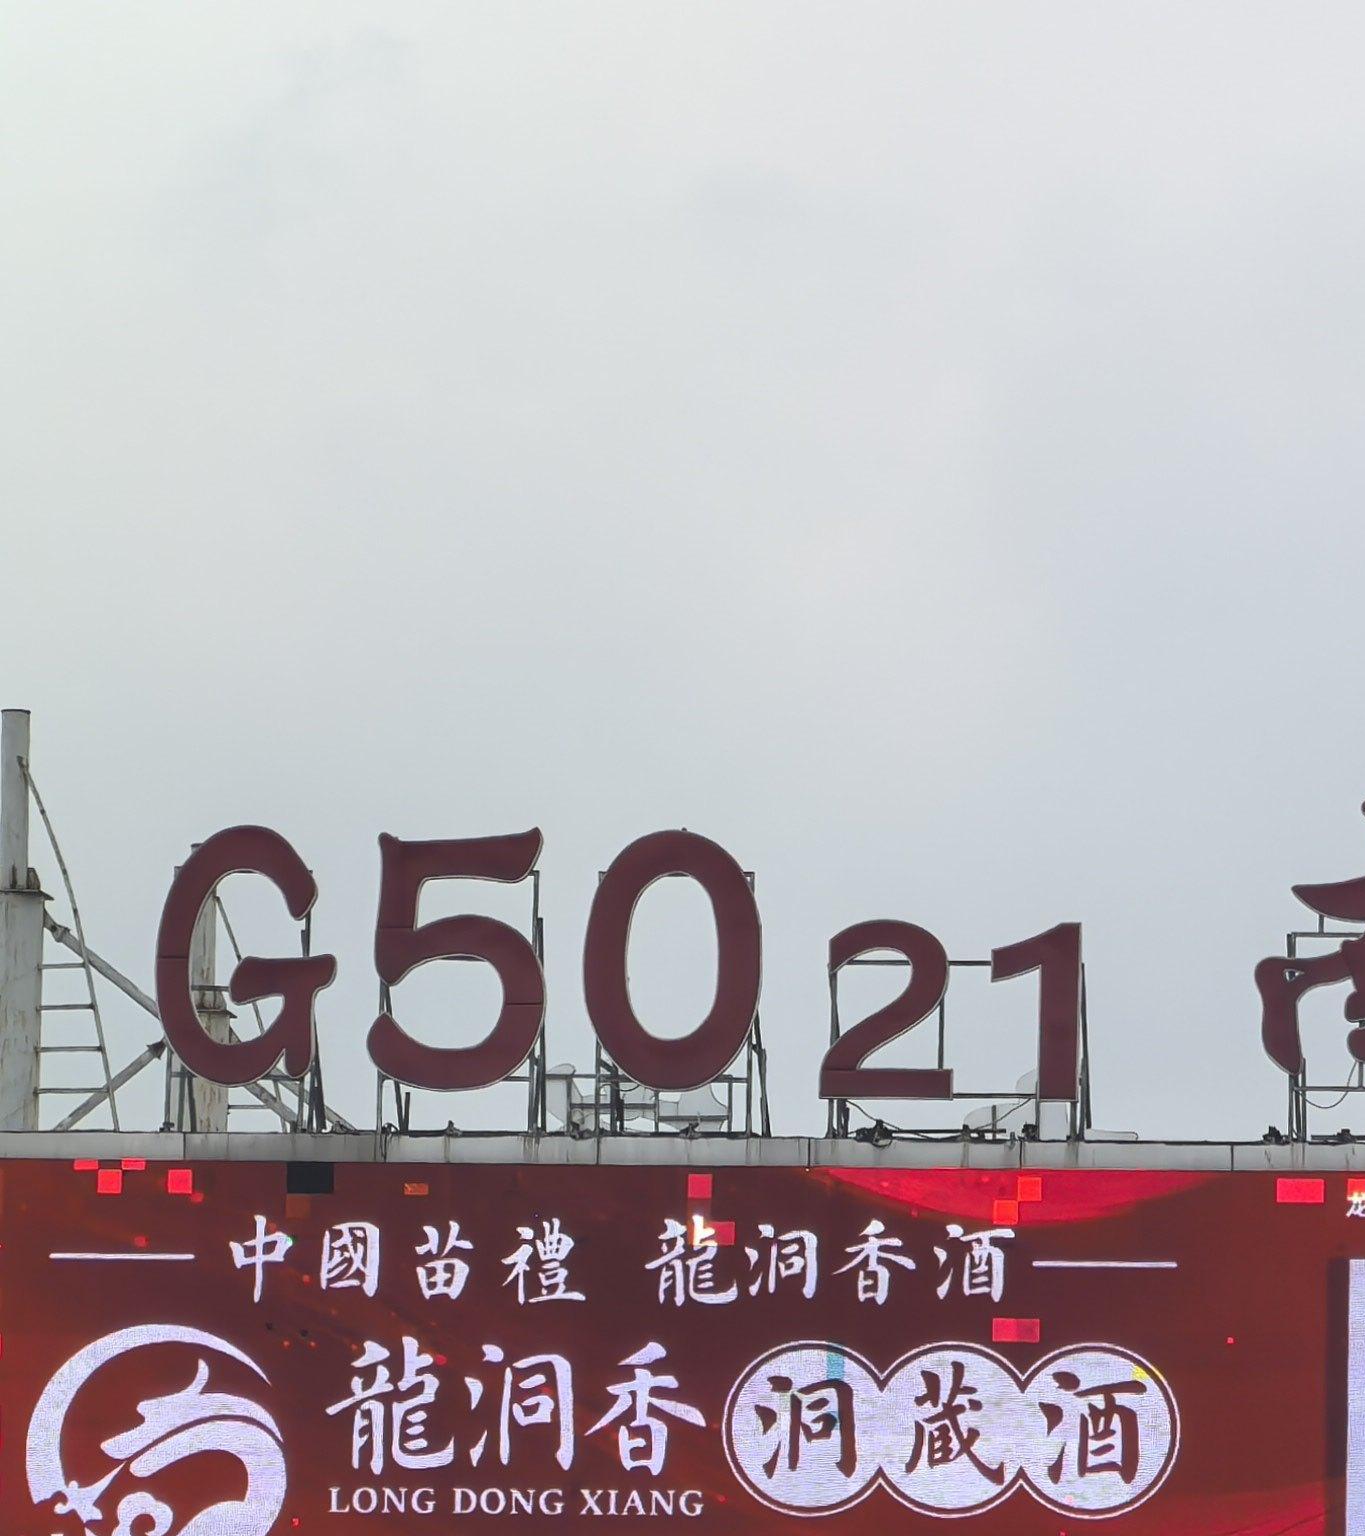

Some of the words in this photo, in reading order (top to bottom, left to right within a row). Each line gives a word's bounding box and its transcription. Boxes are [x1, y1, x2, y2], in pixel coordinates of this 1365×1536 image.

[645, 1214, 1016, 1308] 龍洞香酒
[325, 1335, 708, 1477] 龍洞香
[328, 1486, 436, 1515] LONG
[452, 1487, 565, 1516] DONG
[579, 1488, 704, 1517] XIANG
